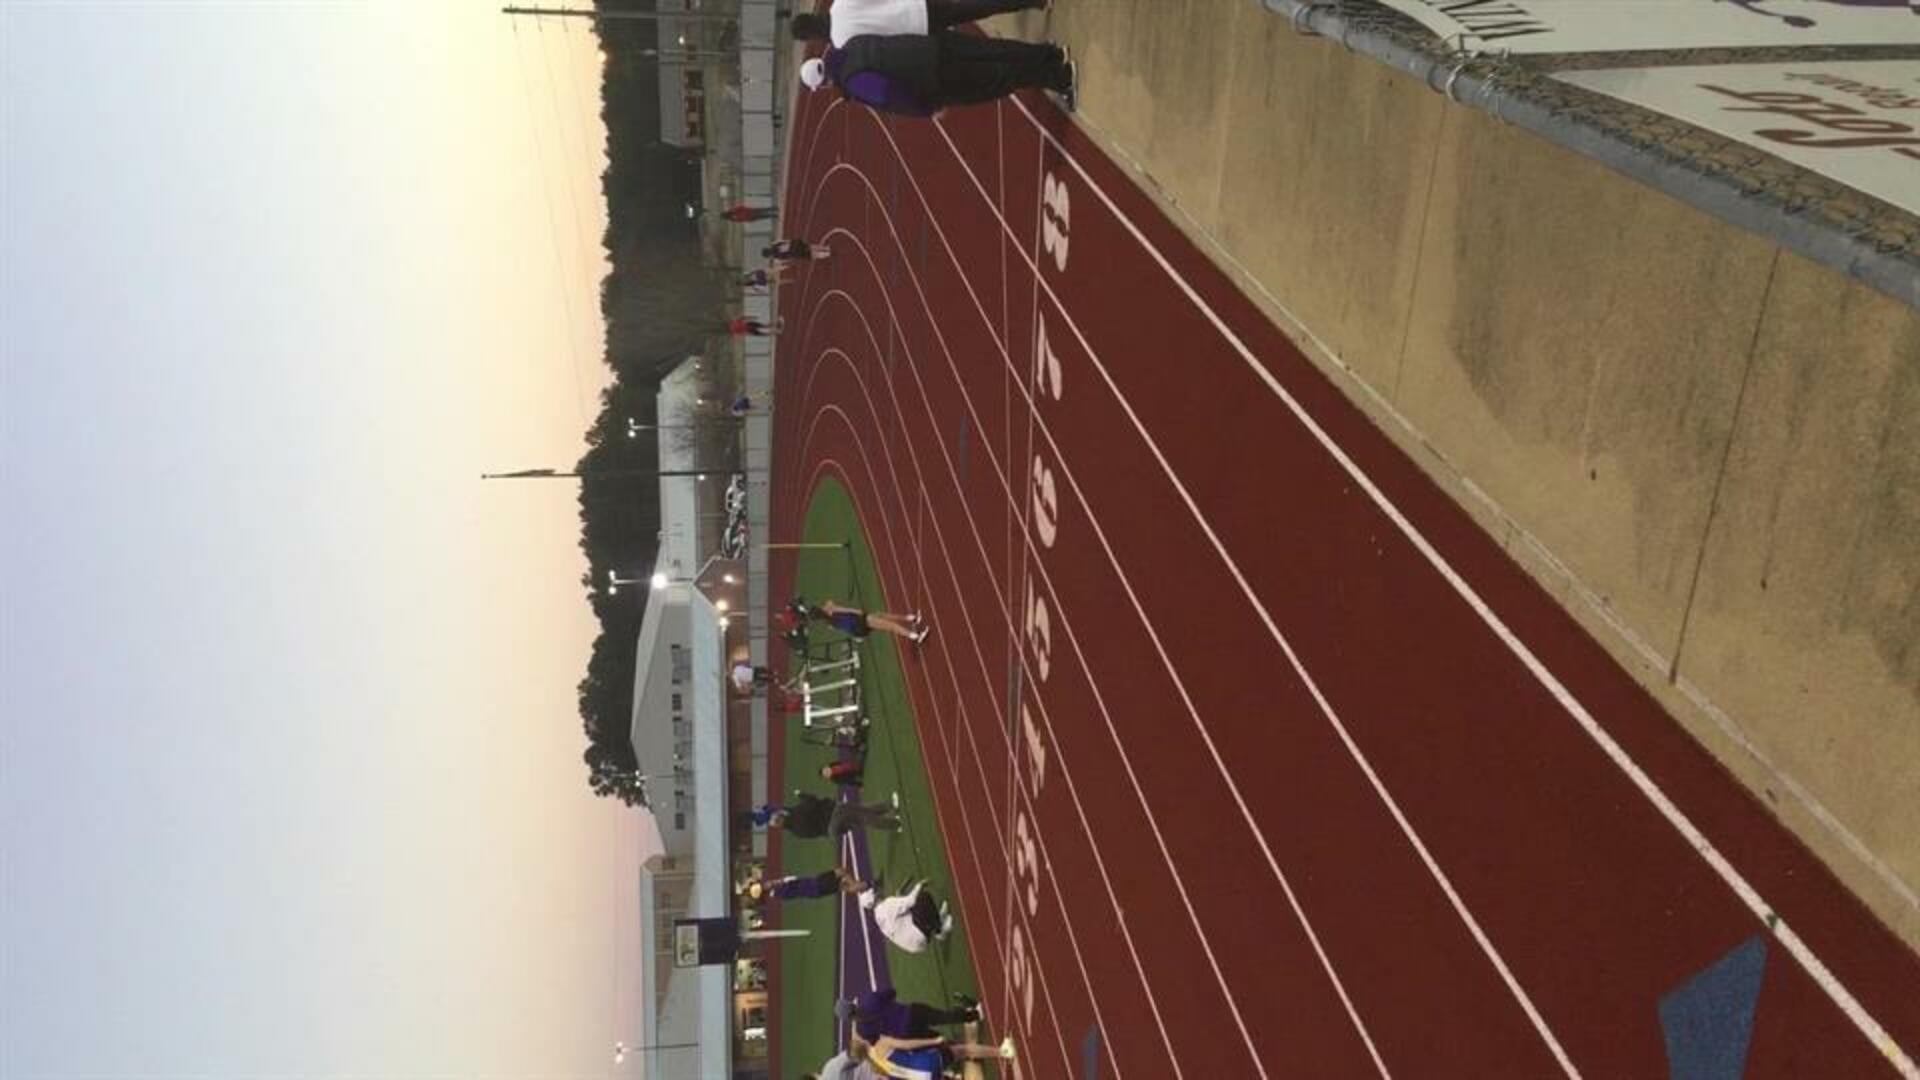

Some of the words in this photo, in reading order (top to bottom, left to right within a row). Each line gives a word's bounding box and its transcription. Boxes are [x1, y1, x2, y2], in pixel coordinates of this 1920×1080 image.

[1043, 171, 1070, 273] 8
[1037, 310, 1062, 401] 7
[1033, 454, 1057, 548] 6
[1026, 572, 1051, 683] 5
[1023, 703, 1046, 798] 4
[1016, 811, 1039, 916] 3
[1012, 924, 1033, 1037] 2
